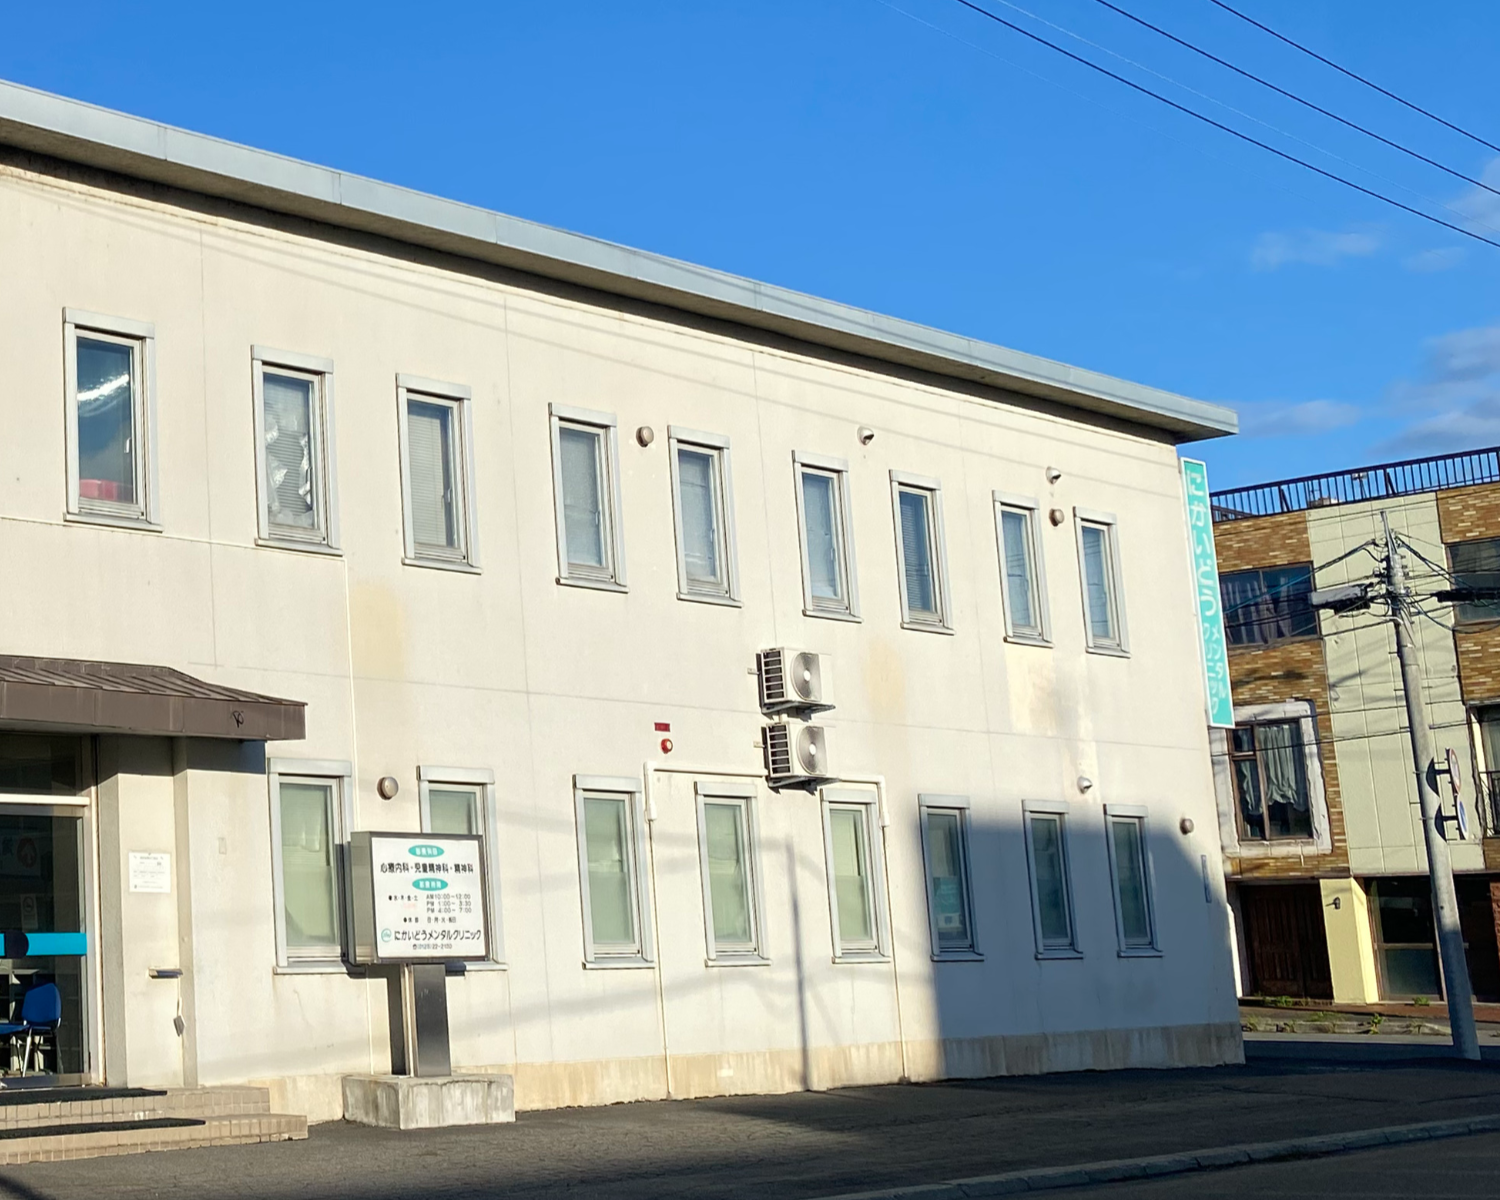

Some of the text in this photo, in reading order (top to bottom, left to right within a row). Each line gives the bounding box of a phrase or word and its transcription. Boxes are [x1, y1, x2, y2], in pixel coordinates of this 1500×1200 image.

[1187, 470, 1217, 616] にかいどう
[1203, 622, 1219, 715] クリニック
[1211, 625, 1228, 699] メンタル
[394, 928, 482, 941] にかいどうメンタルクリニック
